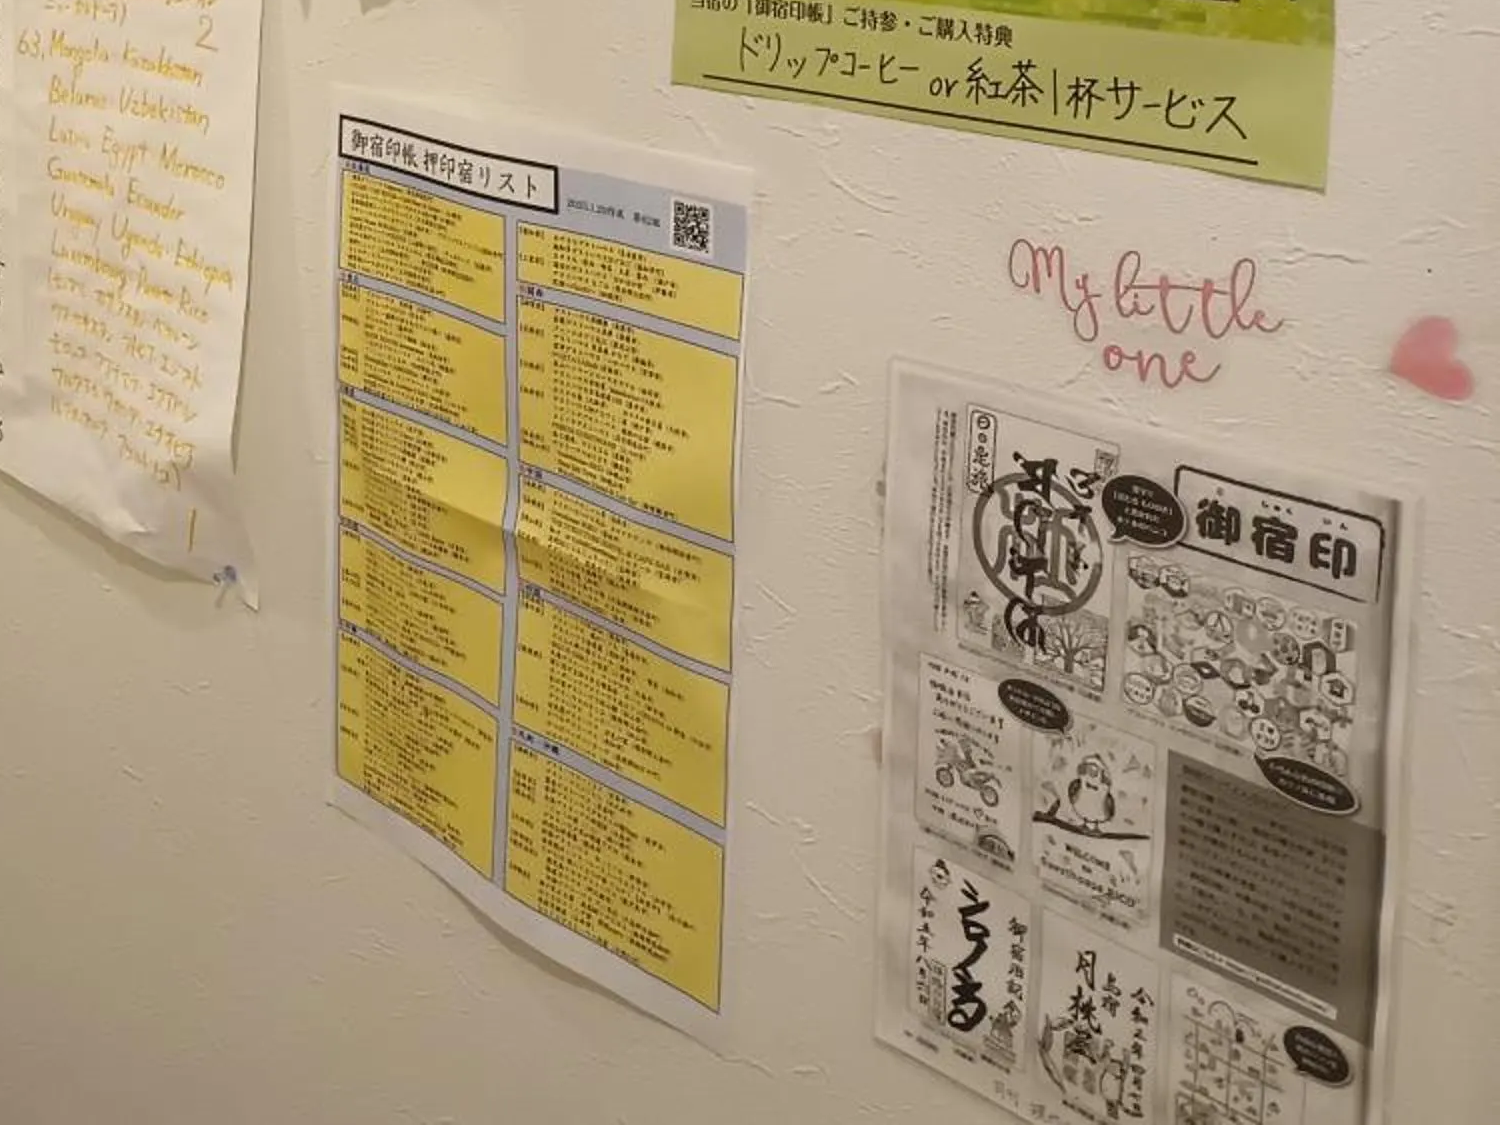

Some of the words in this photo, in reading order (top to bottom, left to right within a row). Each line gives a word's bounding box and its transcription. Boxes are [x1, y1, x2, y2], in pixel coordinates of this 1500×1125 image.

[195, 13, 219, 53] 2
[740, 27, 920, 86] ドリップコーヒー
[930, 75, 954, 97] or
[101, 124, 150, 175] Egypt
[350, 127, 419, 170] 御宿印帳
[1008, 238, 1101, 343] My
[1113, 249, 1286, 340] little
[1102, 343, 1222, 389] one
[185, 507, 198, 554] 1
[1195, 497, 1357, 580] 御宿印
